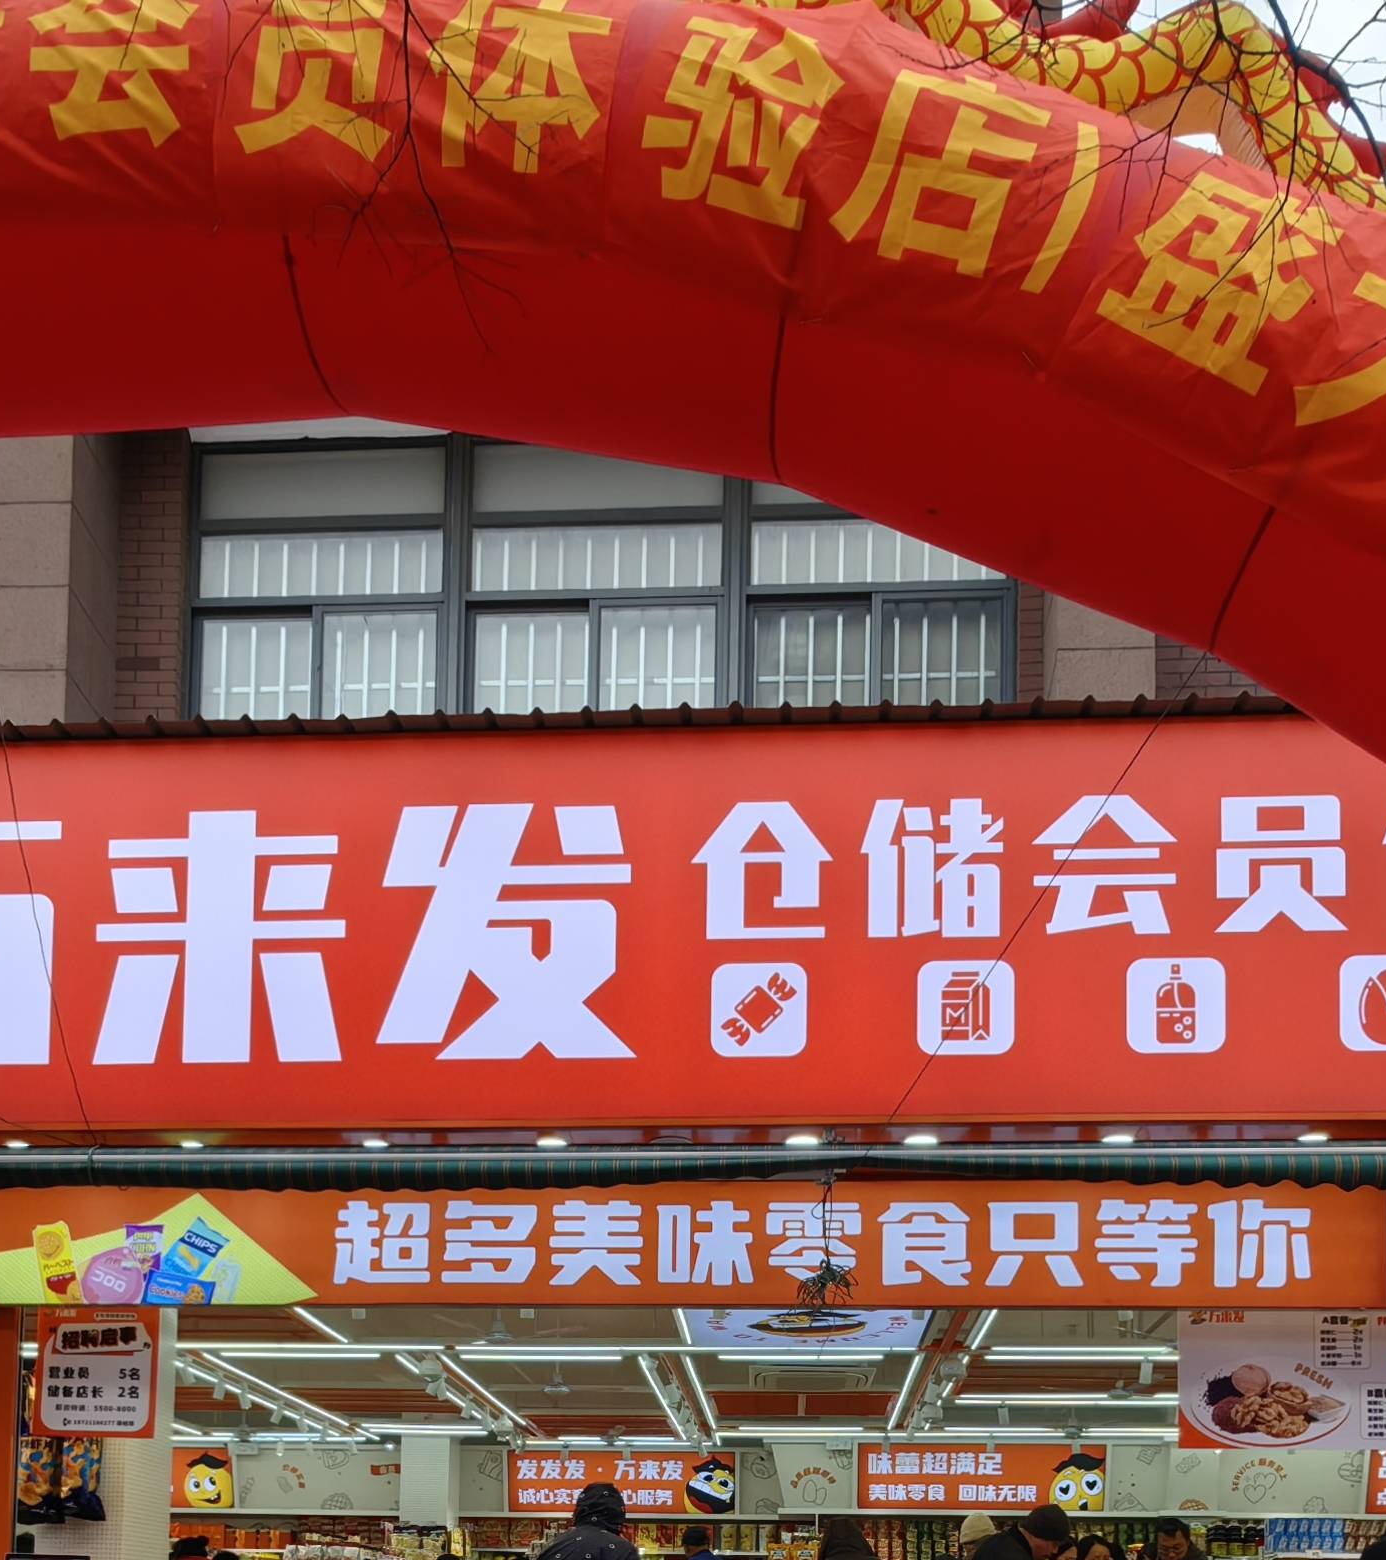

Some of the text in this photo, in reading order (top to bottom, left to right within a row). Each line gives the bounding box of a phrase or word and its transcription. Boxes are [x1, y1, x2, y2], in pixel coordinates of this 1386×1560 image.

[184, 1231, 219, 1254] CHIPS
[333, 1198, 1312, 1288] 超多美味零食只等你
[48, 1366, 141, 1381] 营业员 5名
[47, 1385, 140, 1399] 储备店长 2名
[867, 1452, 1004, 1476] 味蕾超满足
[867, 1484, 1038, 1503] 美味零食 回味无限
